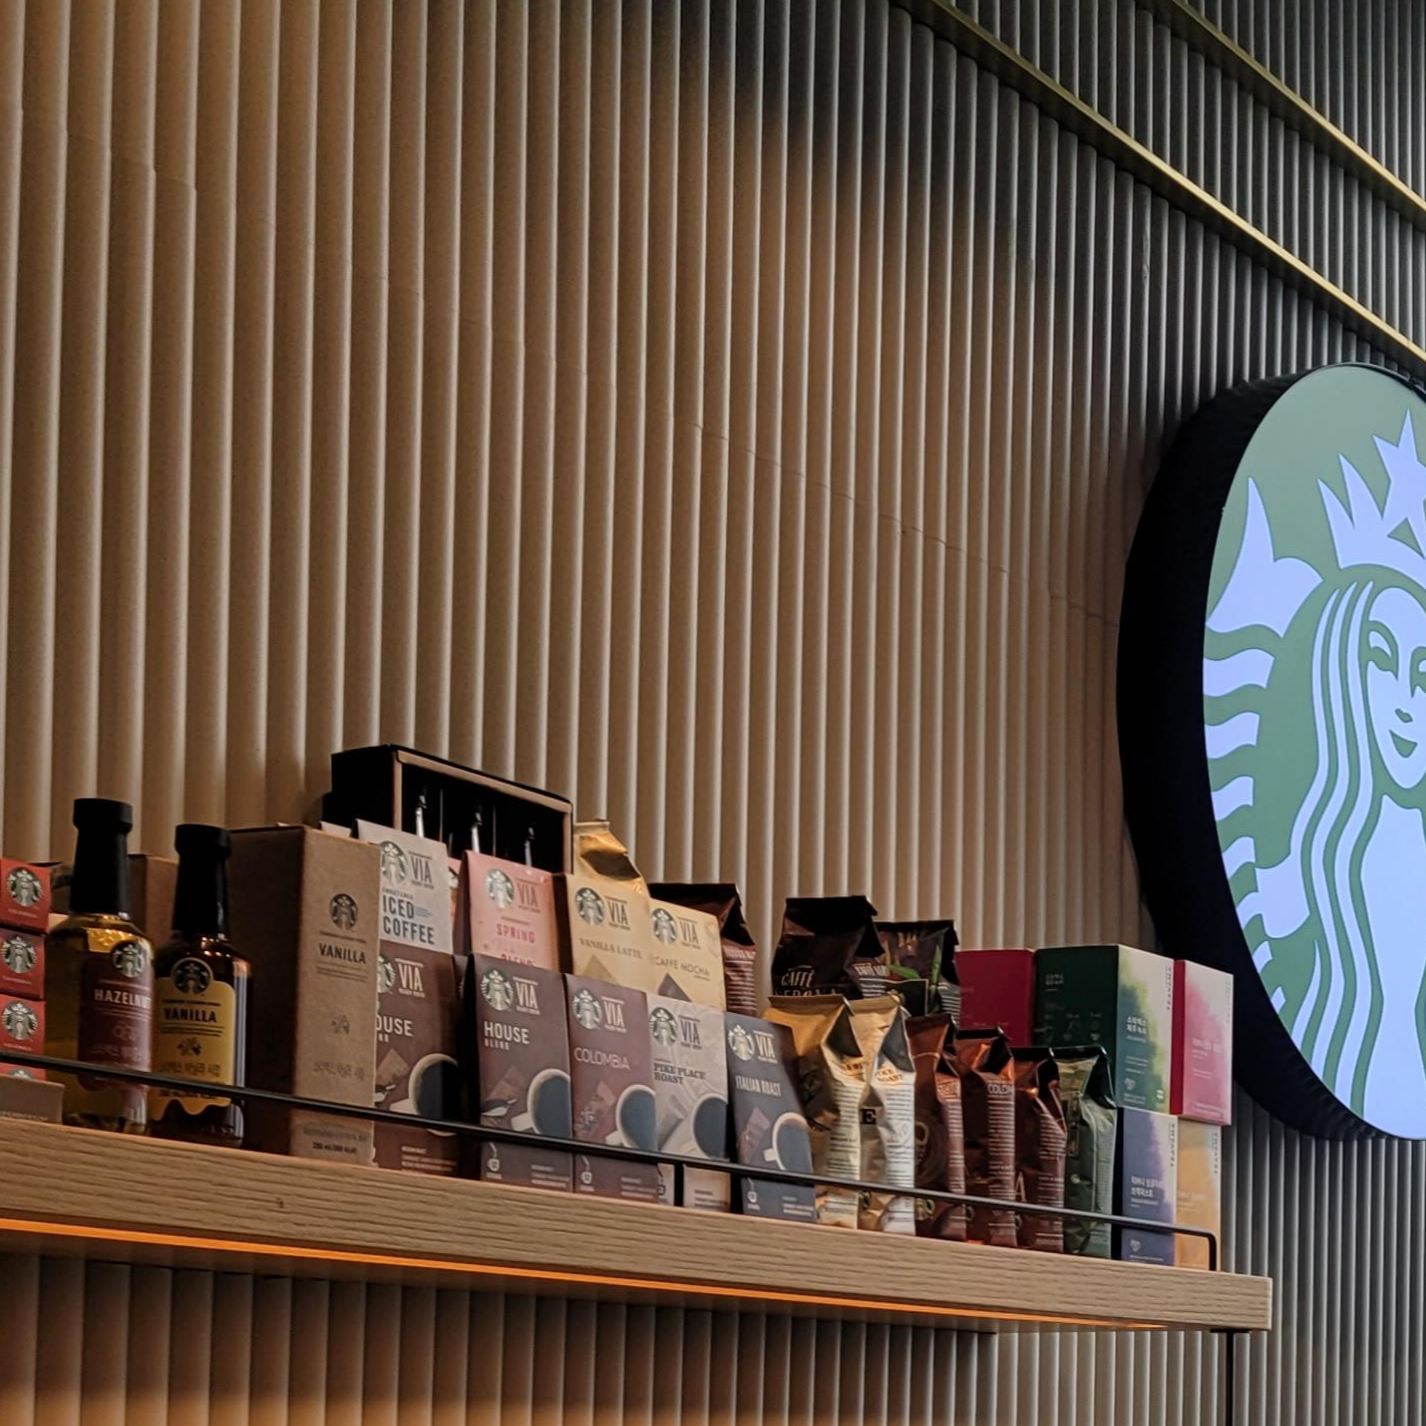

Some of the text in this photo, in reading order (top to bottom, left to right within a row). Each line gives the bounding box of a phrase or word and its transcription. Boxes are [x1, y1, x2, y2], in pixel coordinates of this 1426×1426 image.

[410, 855, 432, 884] VIA
[382, 894, 415, 919] ICED
[517, 882, 539, 908] VIA
[607, 899, 629, 926] VIA
[382, 915, 435, 945] COFFEE
[496, 923, 536, 944] SPRING
[679, 920, 699, 945] VIA
[318, 942, 367, 965] VANILLA
[579, 937, 642, 959] VANILLA LATTE
[398, 962, 423, 992] VIA
[680, 962, 711, 977] MOCHA
[515, 980, 539, 1009] VIA
[164, 1007, 218, 1024] VANILLA
[376, 1014, 413, 1037] OUSE
[603, 1001, 625, 1029] VIA
[484, 1020, 531, 1045] HOUSE
[680, 1018, 701, 1045] VIA
[573, 1046, 631, 1070] COLOMBIA
[754, 1034, 776, 1059] VIA
[654, 1062, 706, 1080] PIKE PLACE
[654, 1072, 684, 1085] ROAST
[735, 1075, 782, 1097] ITALIAN ROAST
